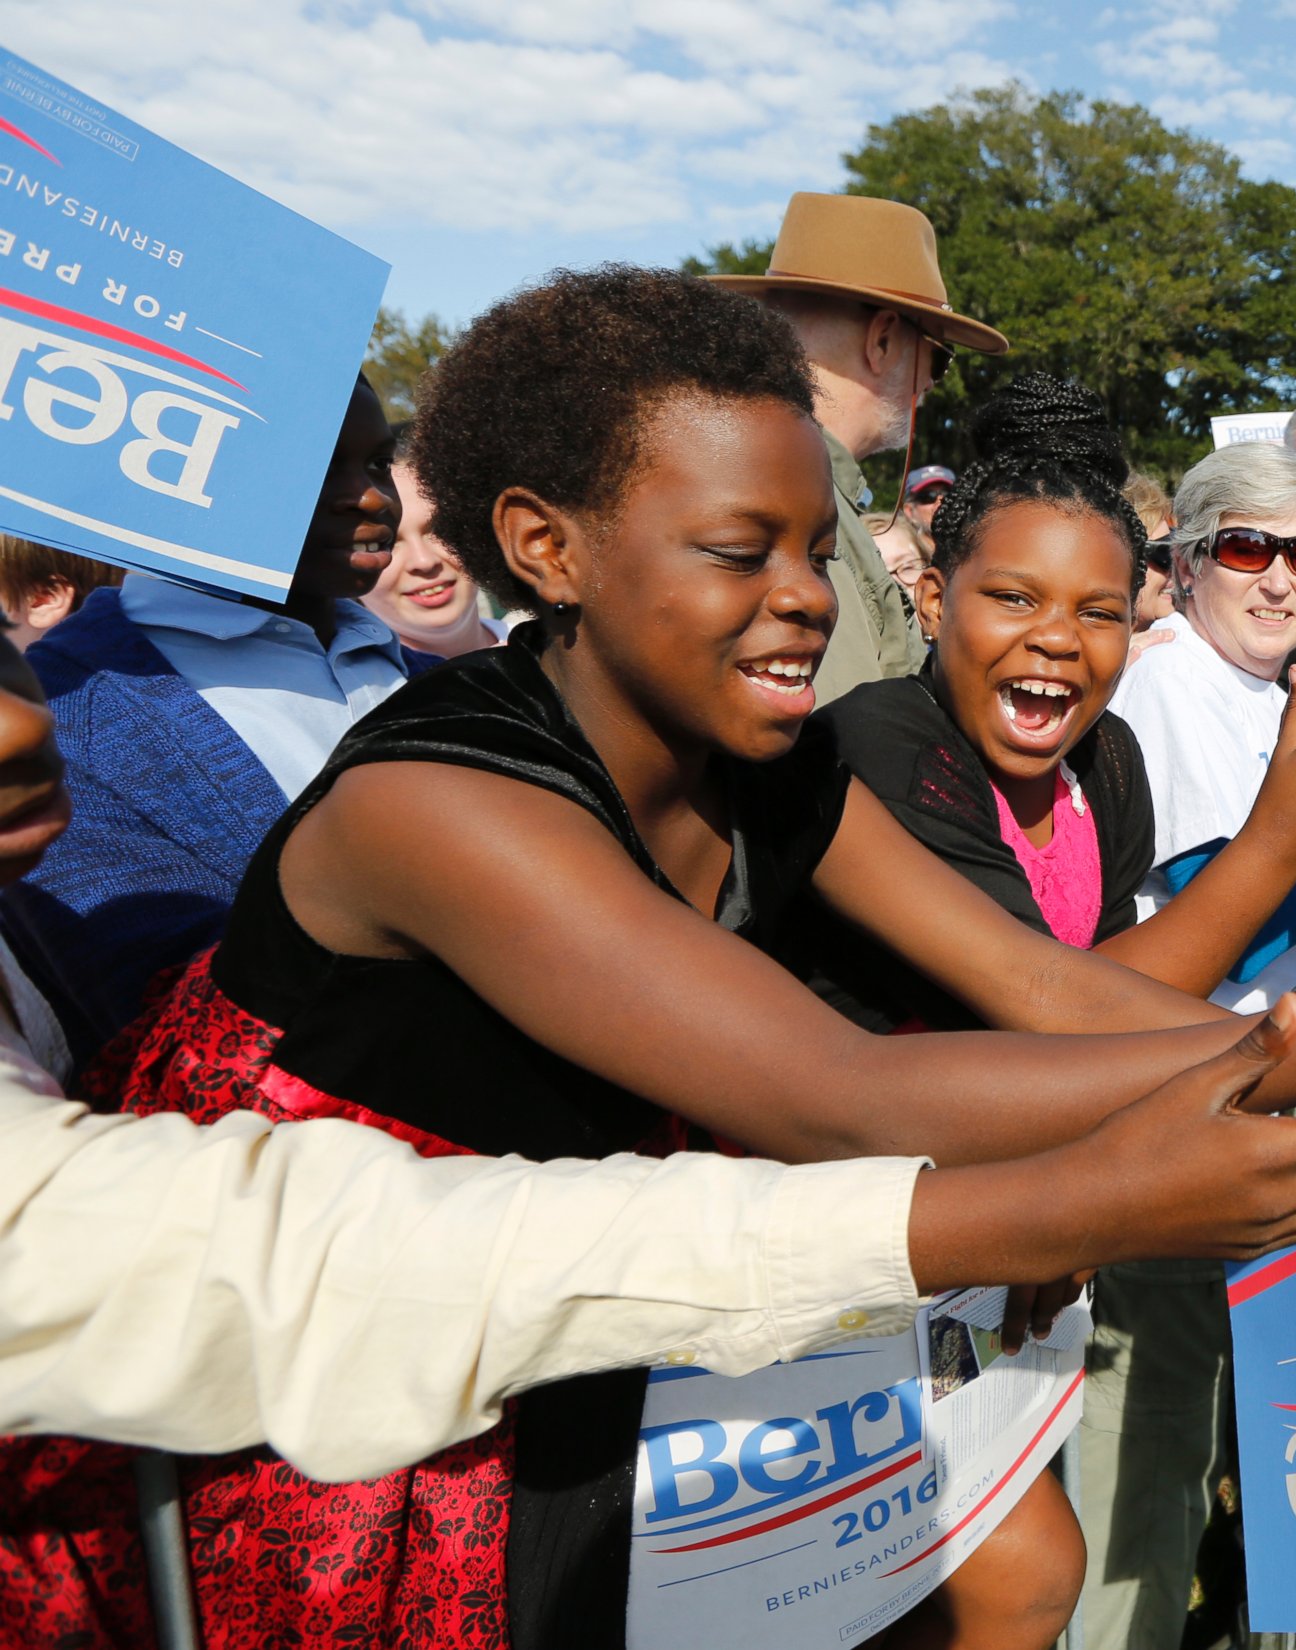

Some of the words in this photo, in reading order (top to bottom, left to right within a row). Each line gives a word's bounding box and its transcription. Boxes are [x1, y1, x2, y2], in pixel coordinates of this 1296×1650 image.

[6, 79, 53, 110] BERNIE
[53, 105, 72, 121] BY
[72, 116, 100, 136] FOR
[100, 130, 131, 153] PAID
[101, 278, 187, 332] FOR
[831, 1470, 938, 1549] 2016
[766, 1468, 996, 1613] BERNIESANDERS.COM
[845, 1616, 868, 1636] PAID
[868, 1605, 889, 1622] FOR
[888, 1596, 901, 1611] BY
[901, 1575, 931, 1600] BERNIE
